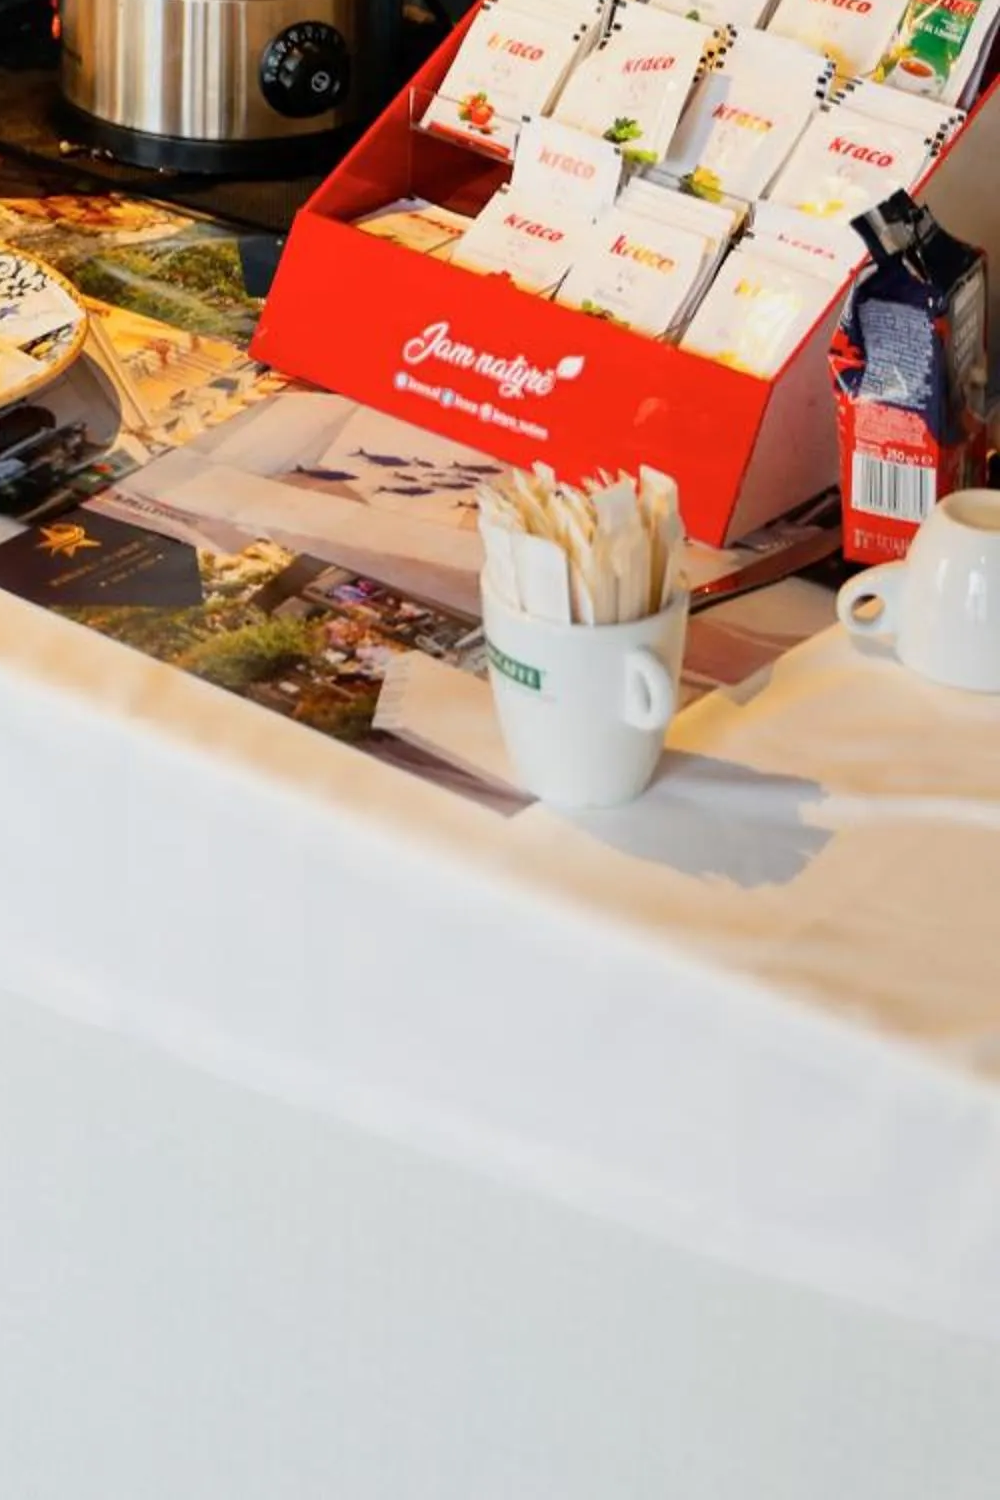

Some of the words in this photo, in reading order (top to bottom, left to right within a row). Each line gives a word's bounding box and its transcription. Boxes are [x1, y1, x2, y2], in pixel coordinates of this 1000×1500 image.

[621, 54, 676, 74] kraco
[538, 145, 596, 180] kraco
[828, 136, 894, 169] kraco
[504, 213, 565, 243] kraco
[403, 321, 475, 367] Jam
